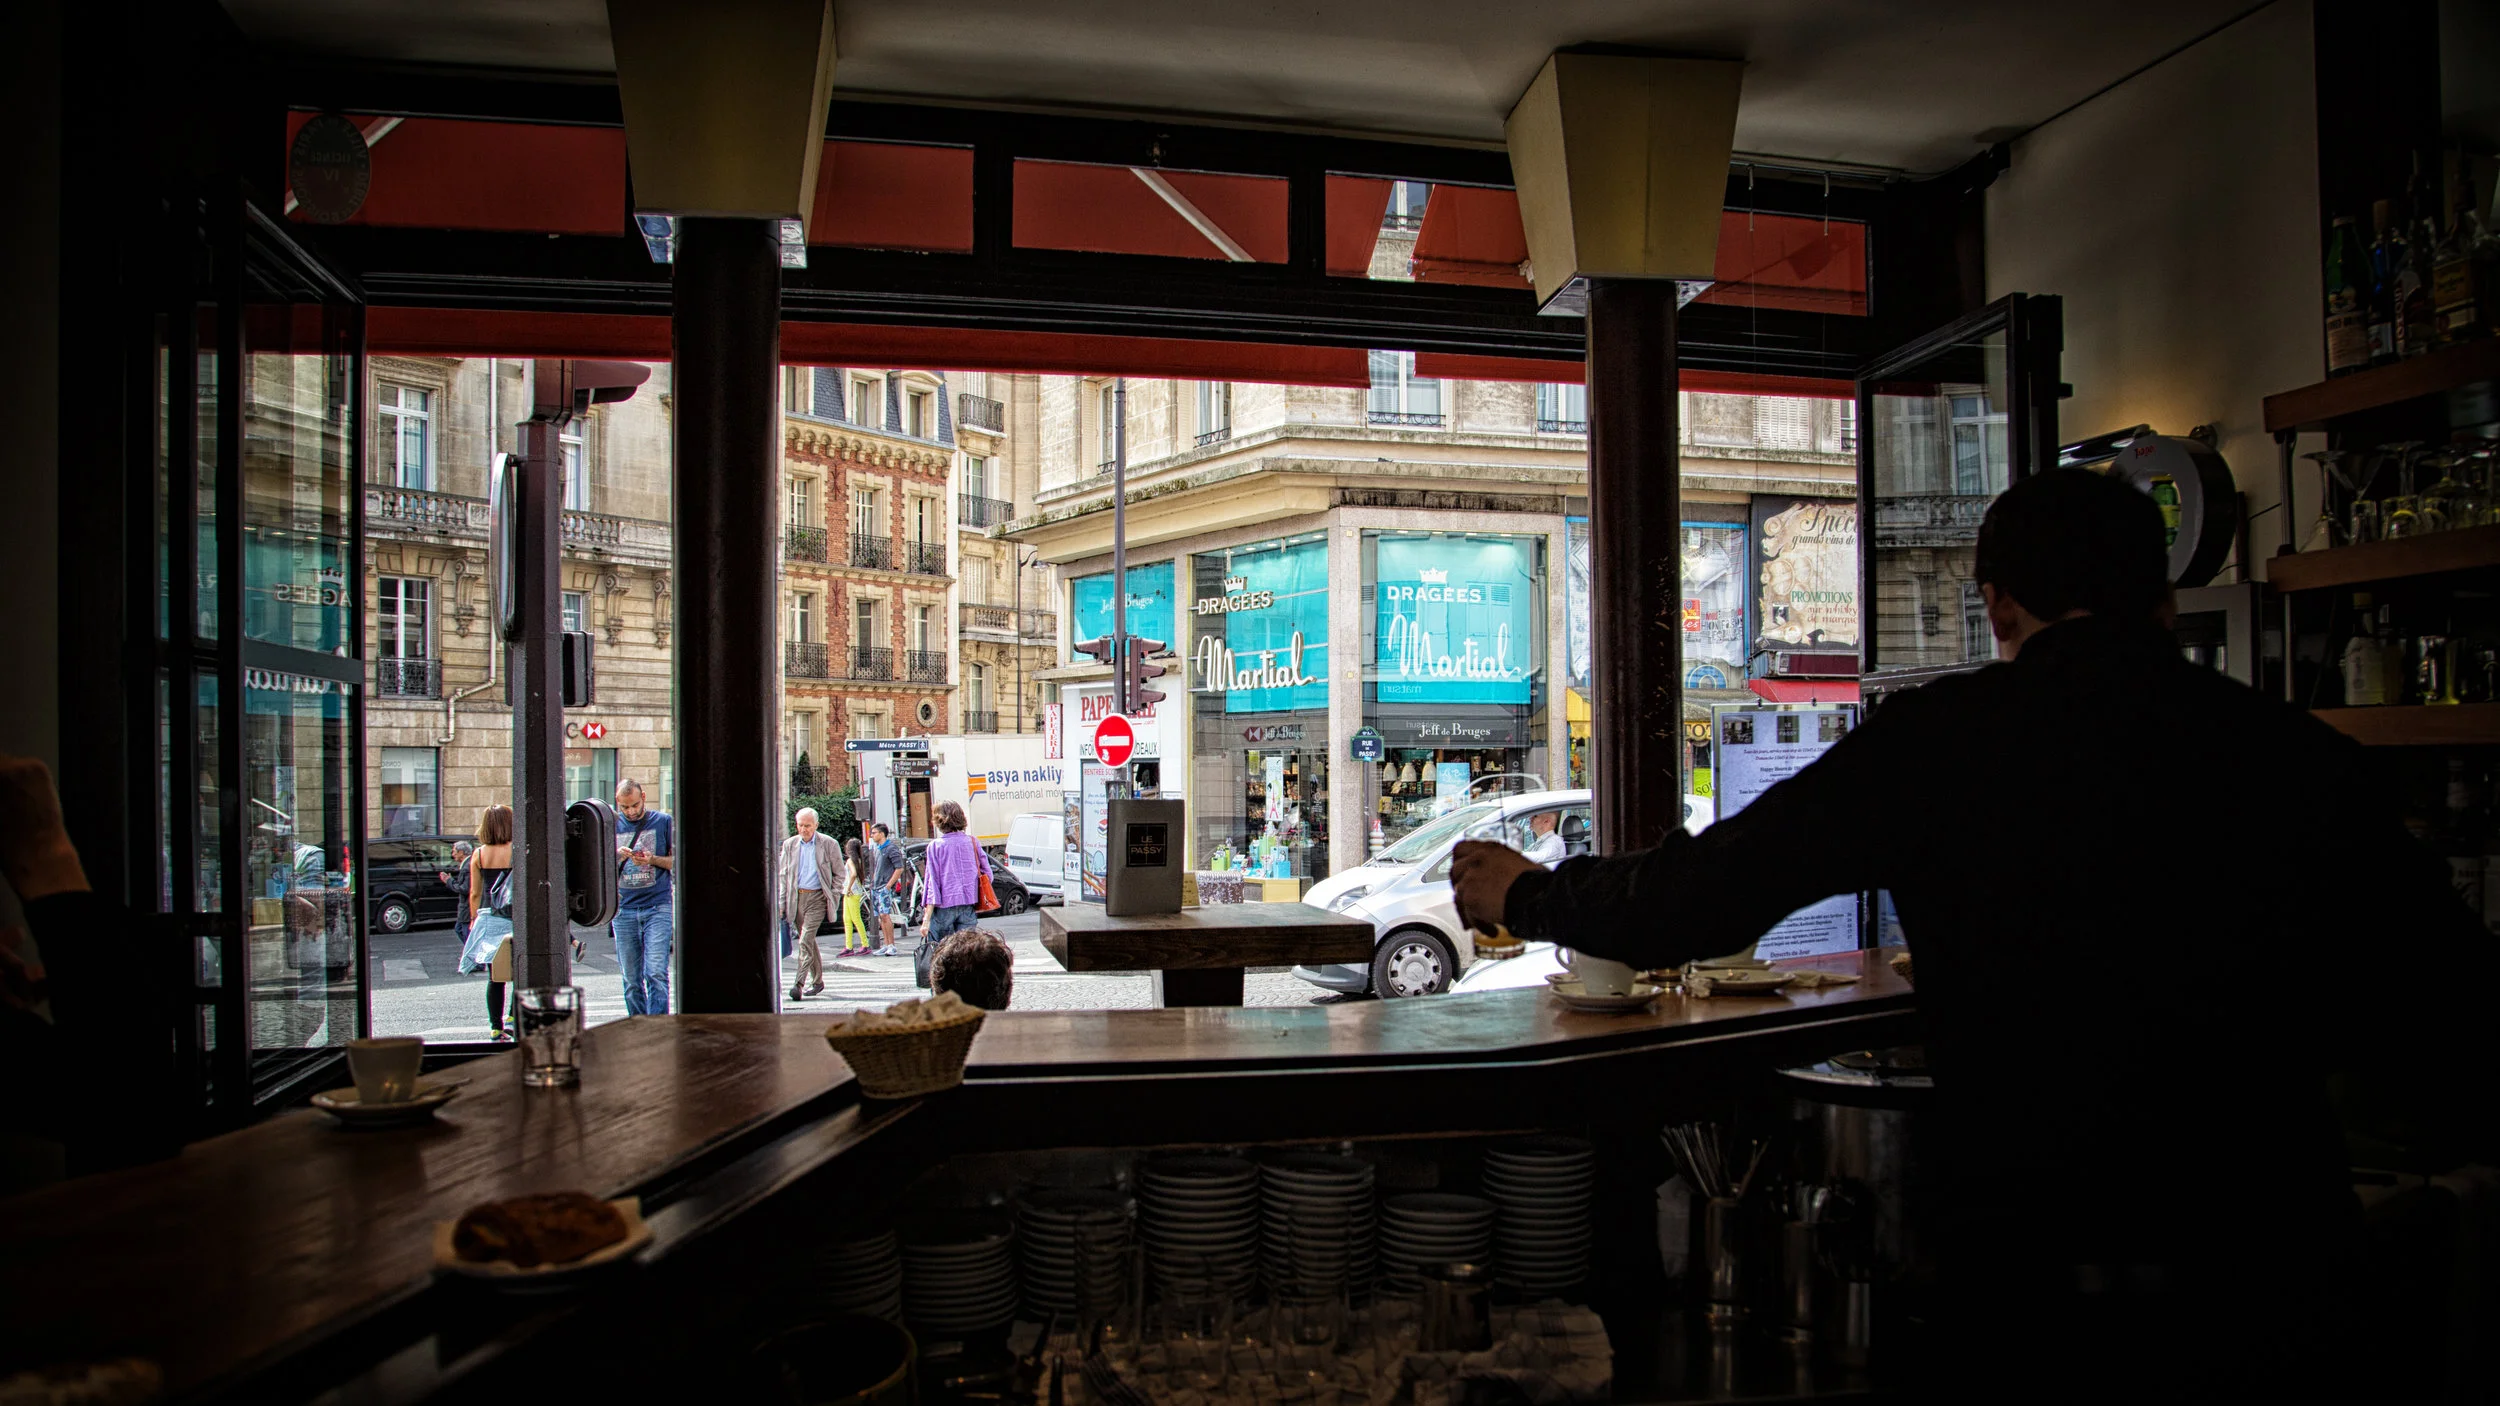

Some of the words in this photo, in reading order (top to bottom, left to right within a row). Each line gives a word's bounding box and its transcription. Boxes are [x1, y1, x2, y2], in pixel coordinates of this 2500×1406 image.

[1791, 591, 1853, 604] PROMOTIONS
[1388, 614, 1522, 679] Martial
[1197, 631, 1317, 693] Martial
[1419, 724, 1440, 738] Jeff
[1441, 728, 1450, 736] de
[1452, 723, 1491, 738] Bruges
[878, 741, 896, 749] Métro
[898, 741, 917, 749] PASSY
[1080, 743, 1095, 756] INFO
[988, 769, 1019, 787] asya
[1023, 764, 1064, 785] nakliy
[989, 788, 1043, 801] international
[1141, 835, 1153, 843] LE
[1130, 846, 1162, 855] PASSY
